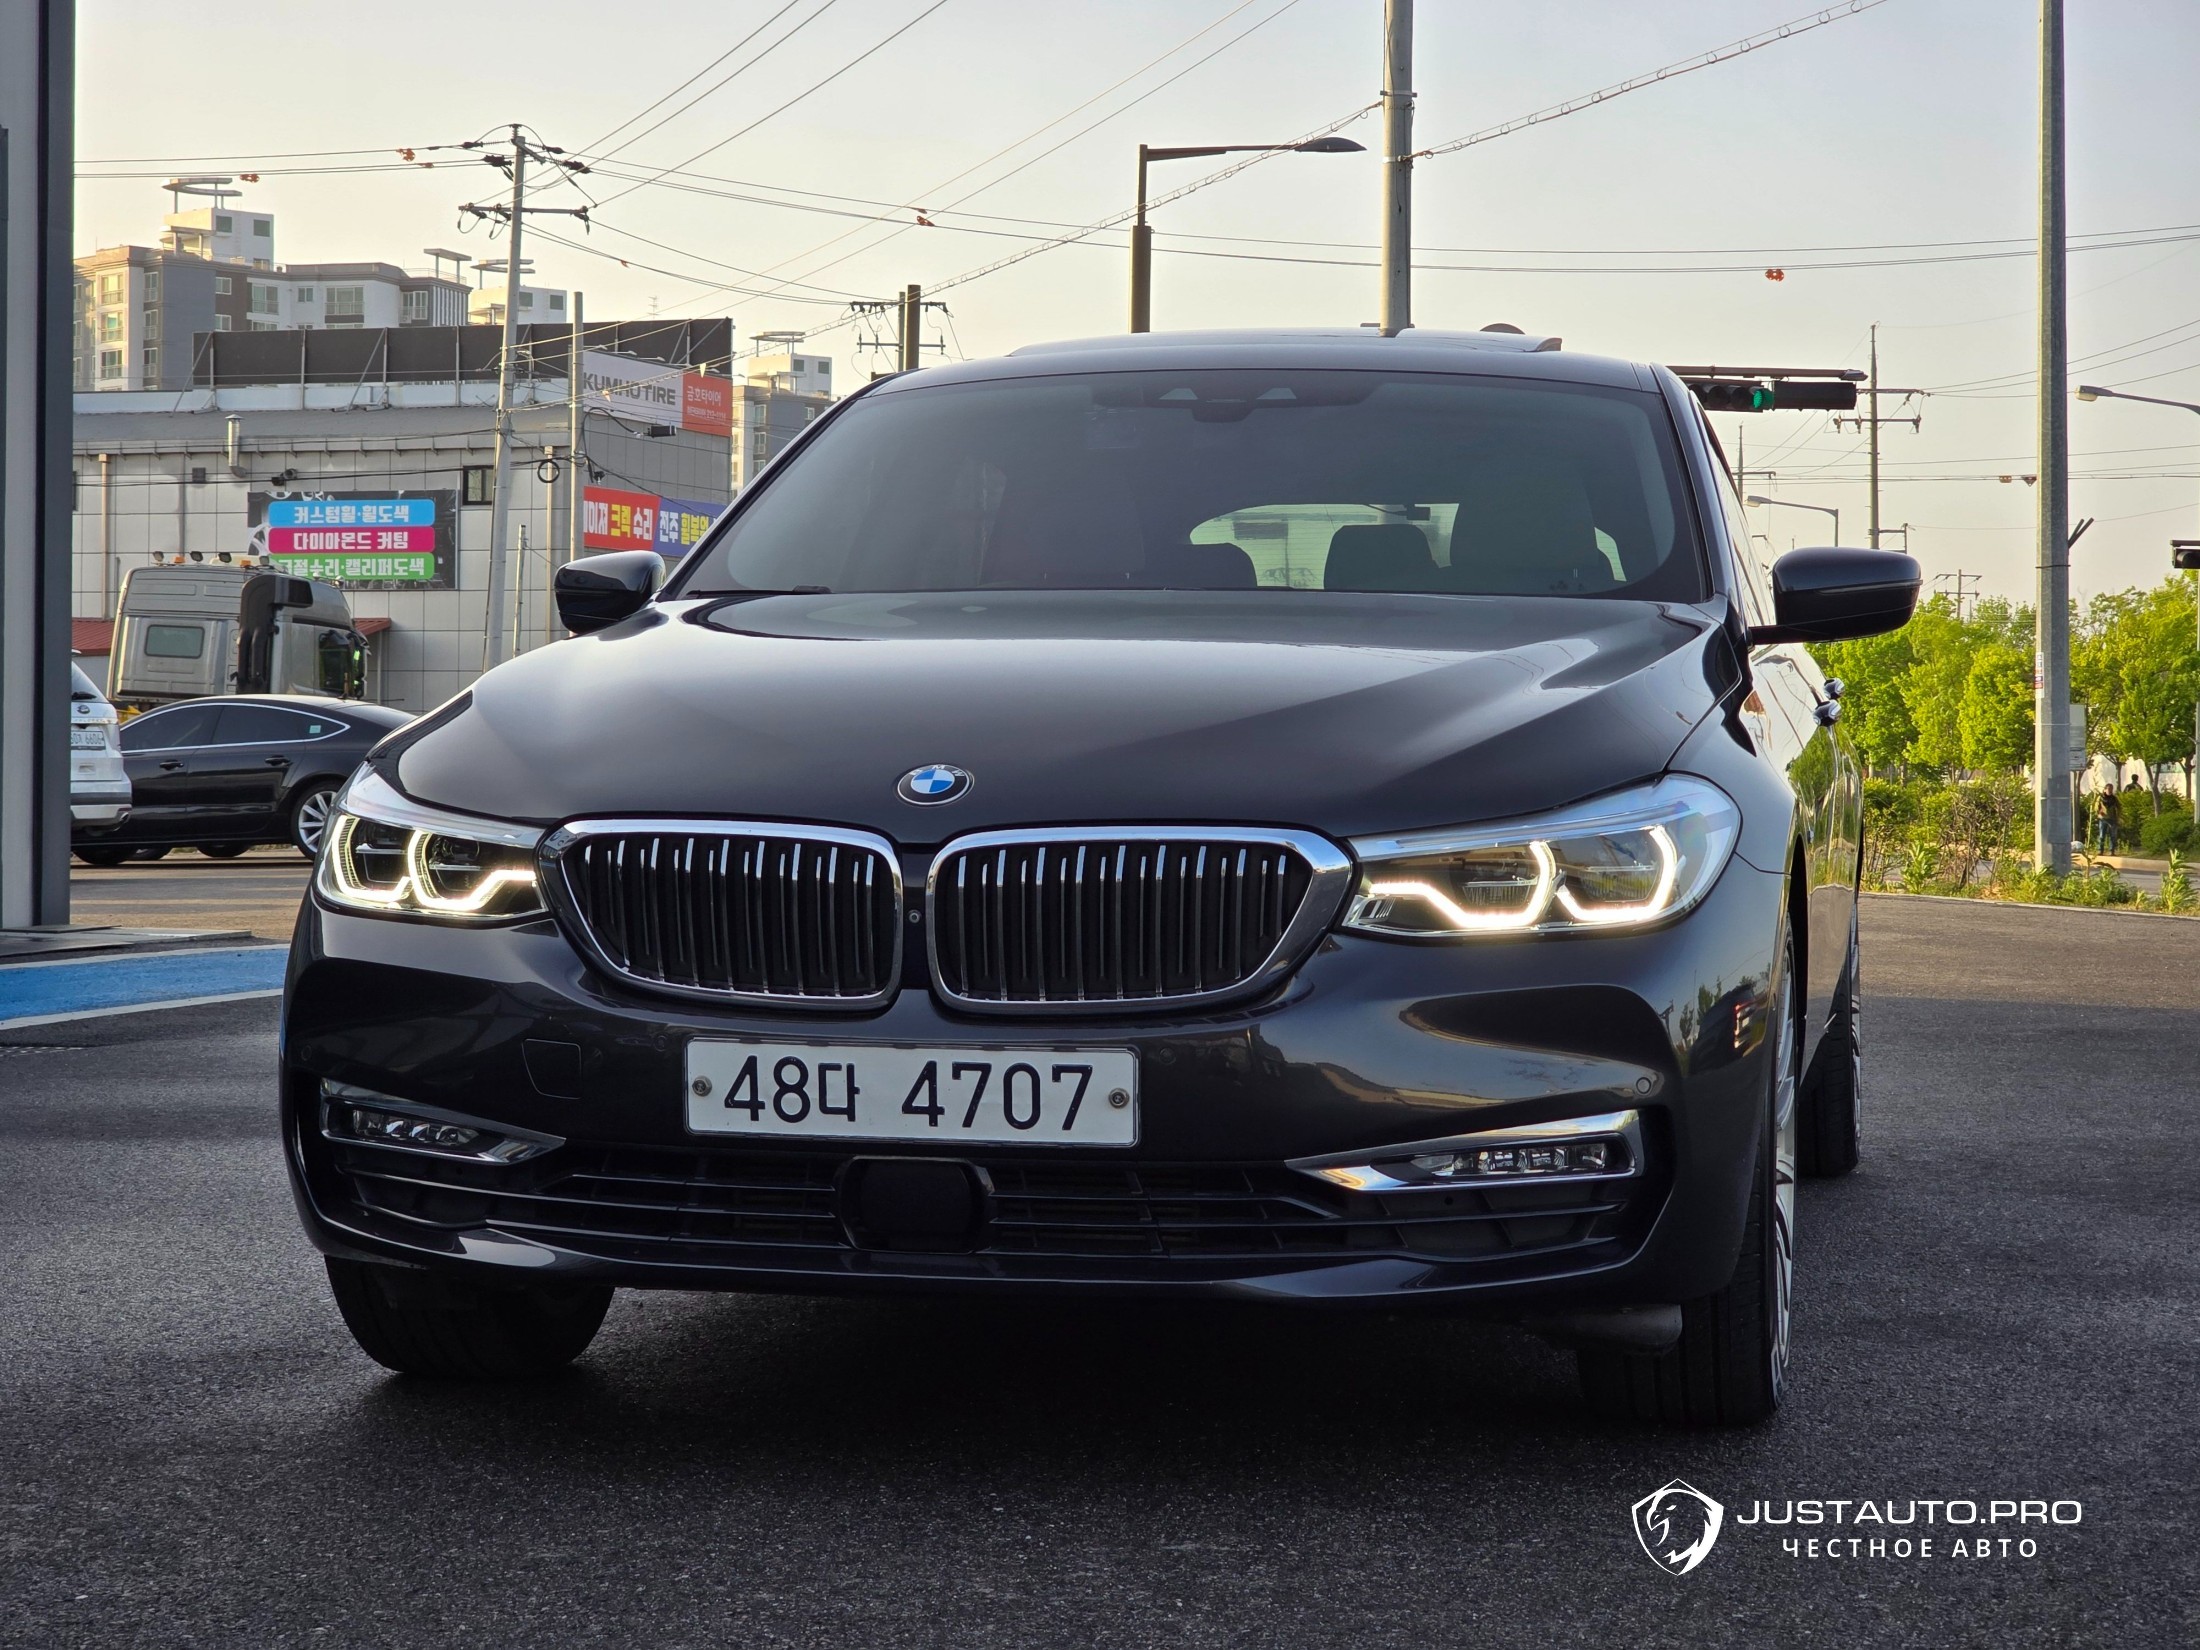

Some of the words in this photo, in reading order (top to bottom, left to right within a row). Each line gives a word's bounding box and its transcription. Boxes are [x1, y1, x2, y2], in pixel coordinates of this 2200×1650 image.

[583, 372, 641, 399] KUMHO
[642, 384, 676, 406] TIRE
[686, 385, 722, 407] 금호타이어
[611, 503, 631, 538] 크랙
[633, 507, 653, 541] 수리
[659, 510, 679, 544] 전주
[293, 532, 372, 550] 다이아몬드
[377, 531, 409, 550] 커팅
[723, 1055, 861, 1123] 48다
[901, 1060, 1094, 1131] 4707
